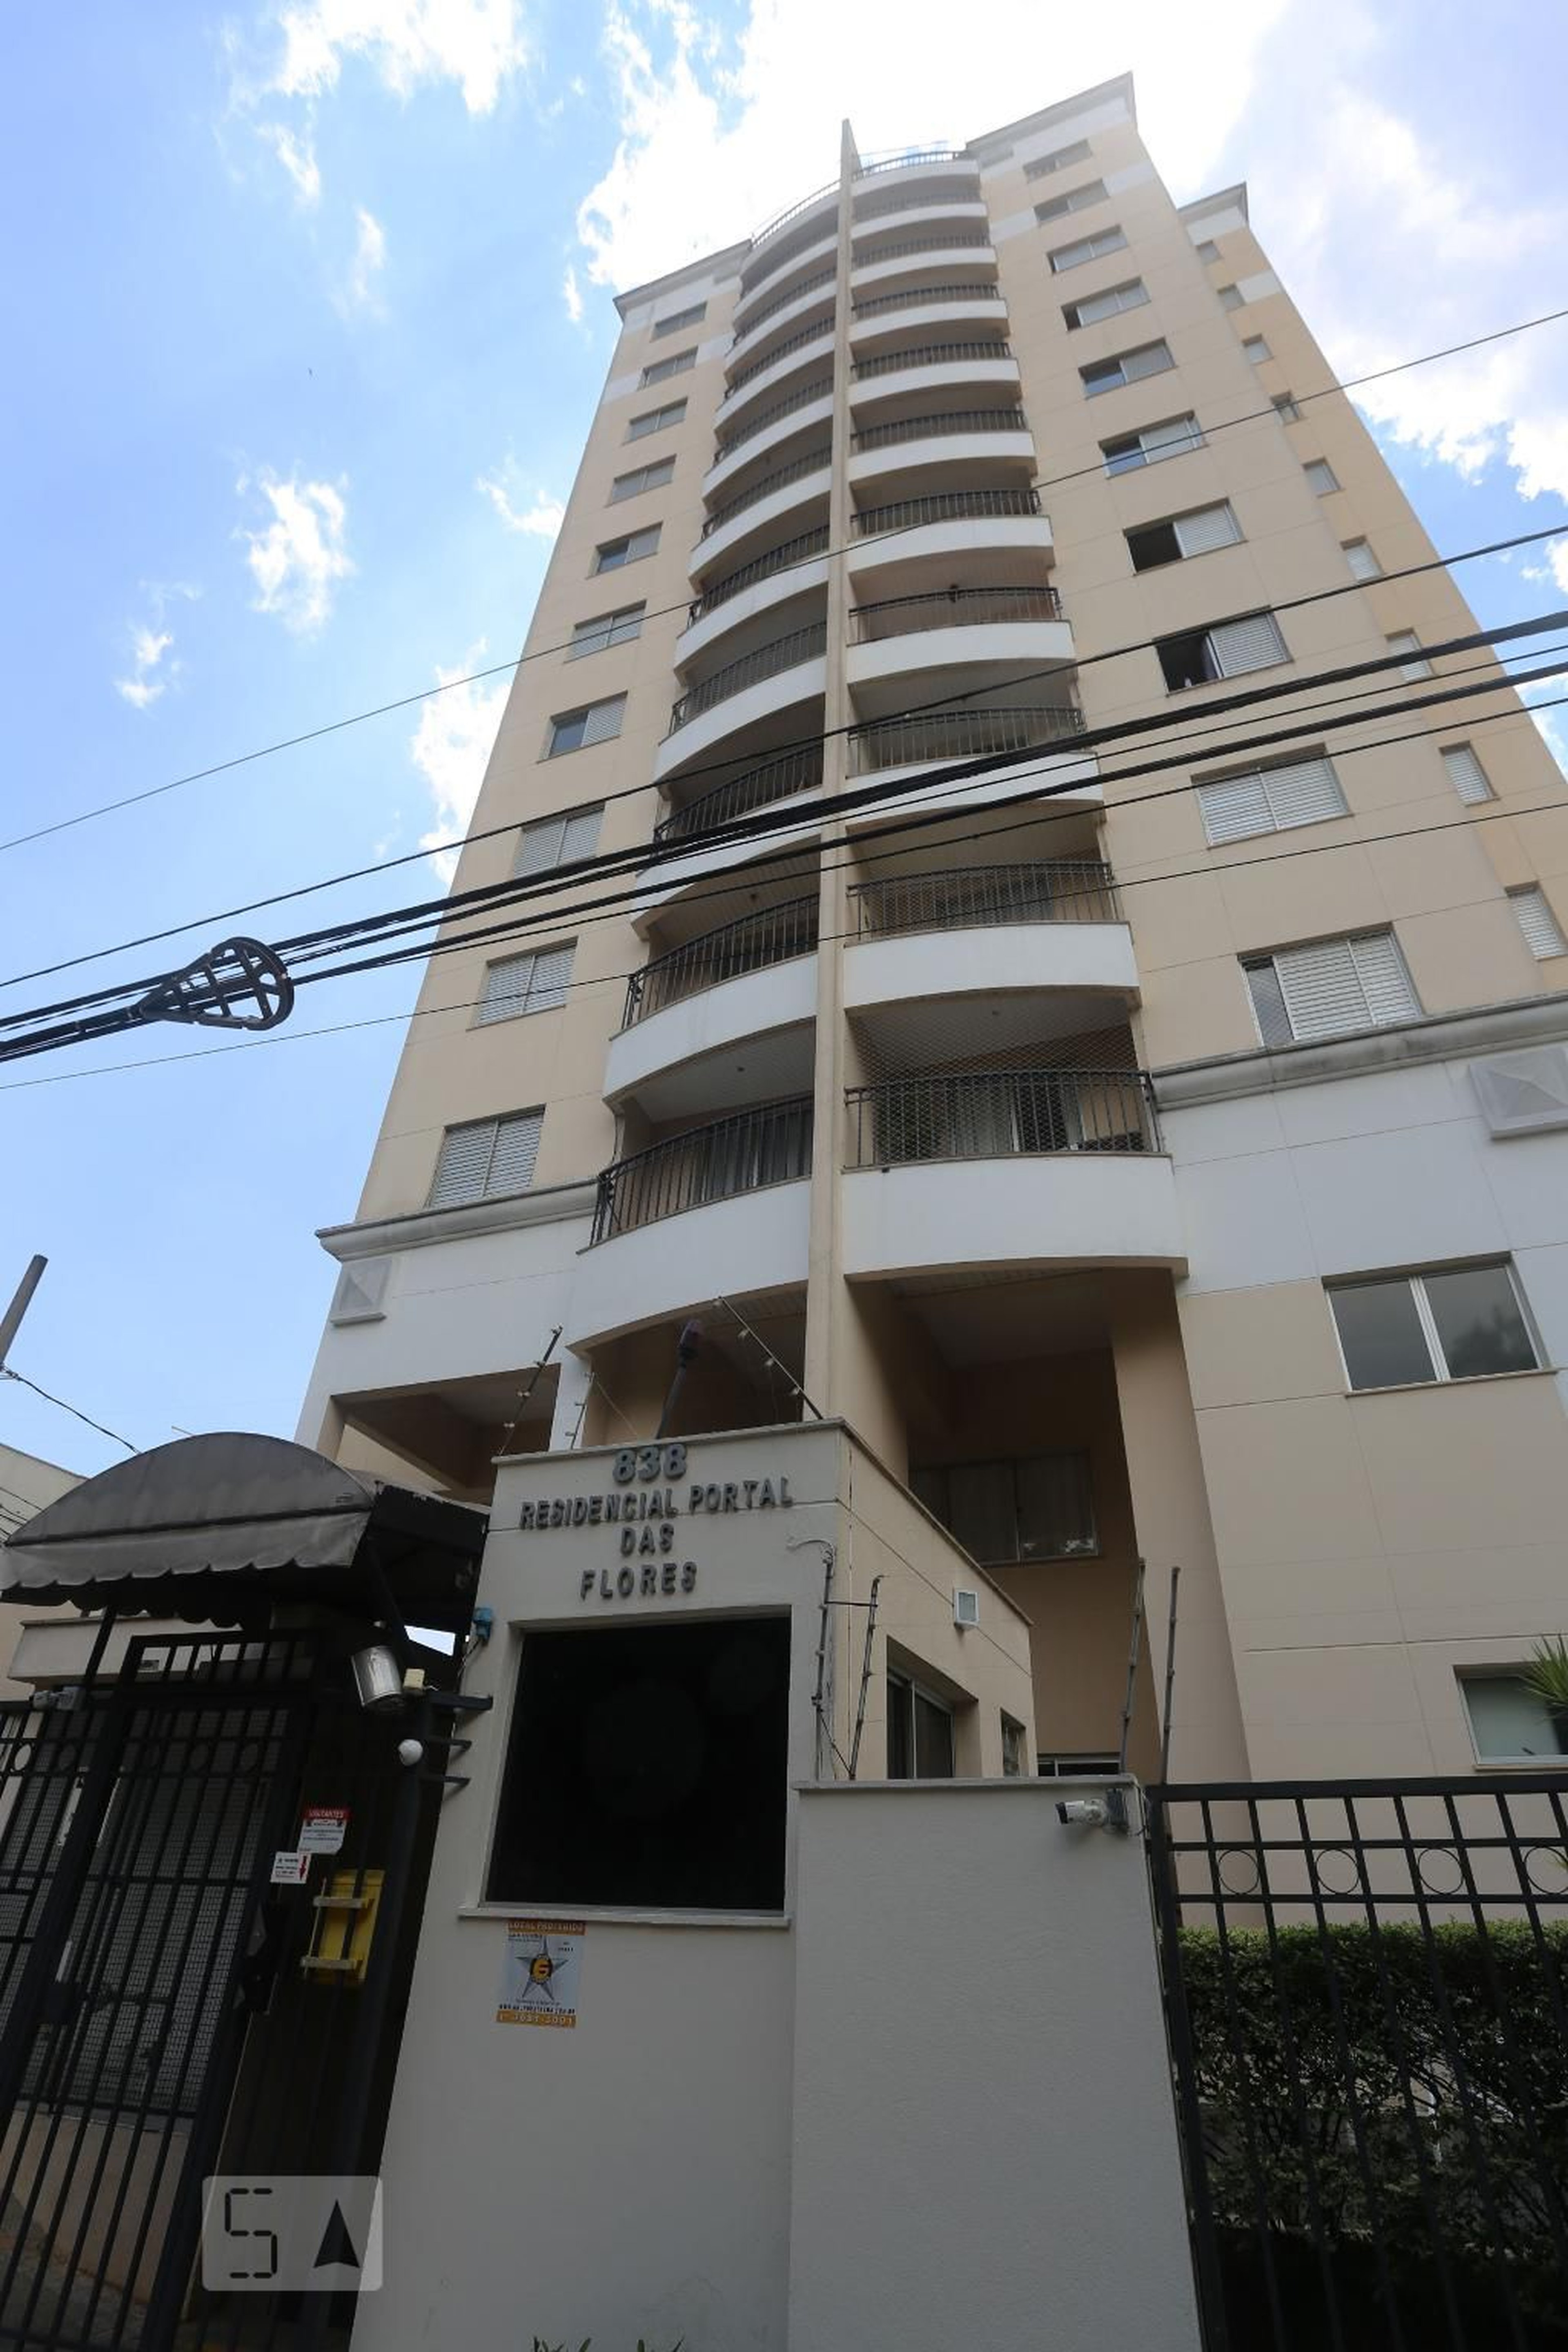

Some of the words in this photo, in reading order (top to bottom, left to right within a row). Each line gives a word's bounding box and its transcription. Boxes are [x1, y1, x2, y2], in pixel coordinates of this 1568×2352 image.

[613, 1443, 687, 1483] 838
[519, 1488, 678, 1530] RESIDENCIAL
[689, 1477, 793, 1514] PORTAL
[620, 1523, 675, 1556] DAS
[580, 1561, 697, 1600] FLORES
